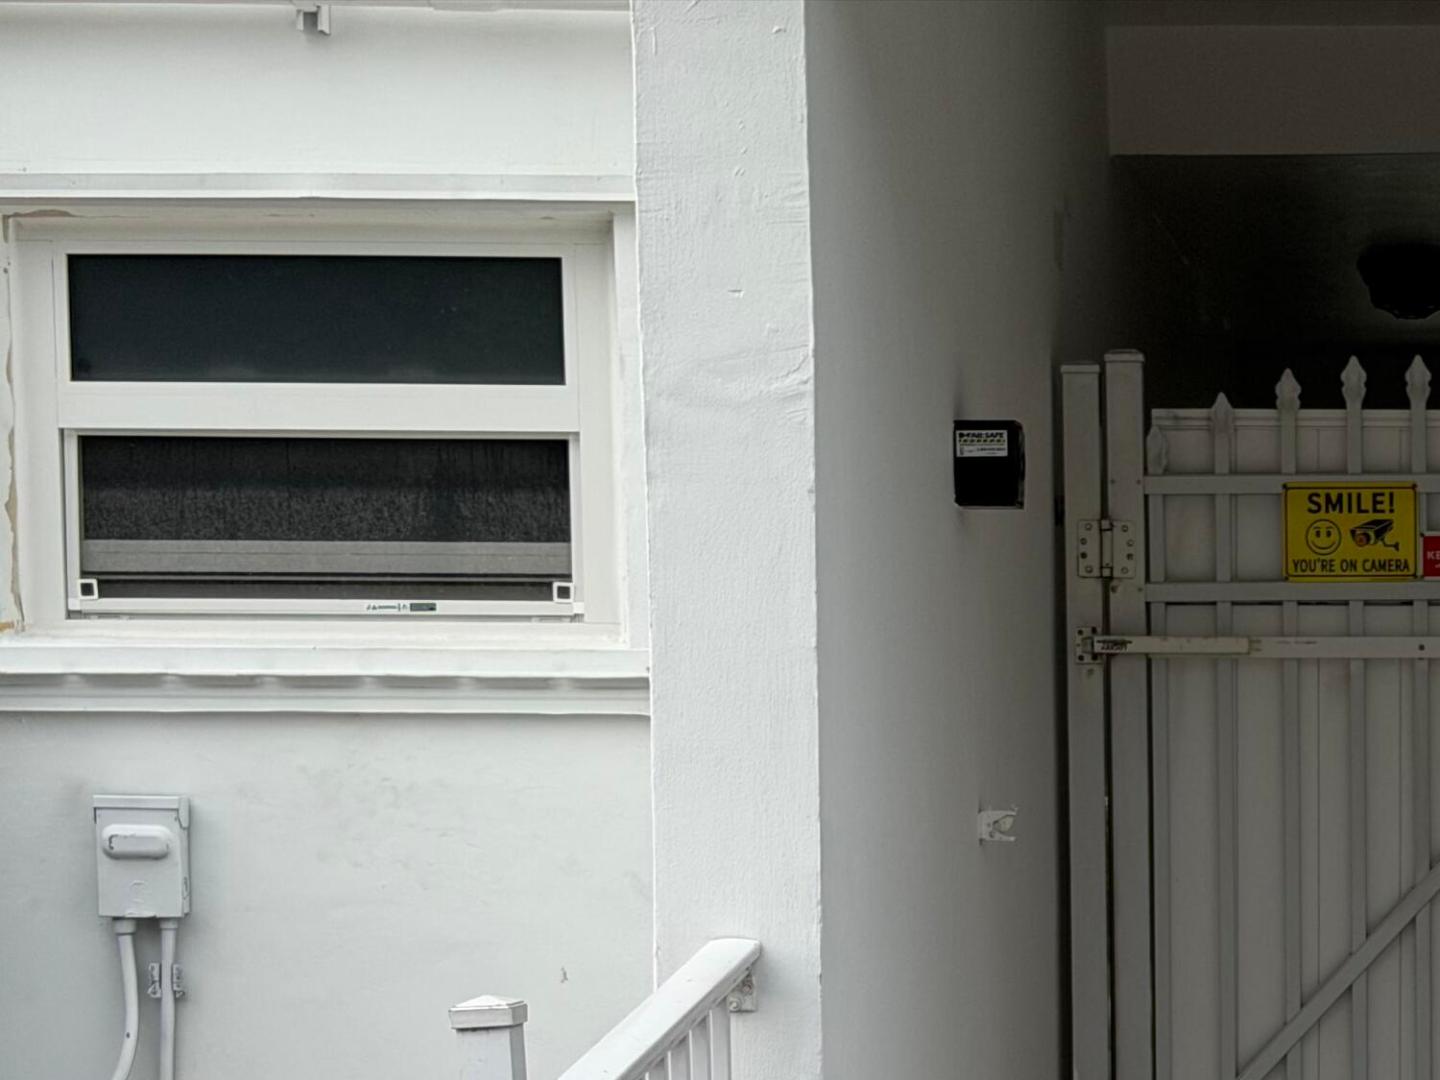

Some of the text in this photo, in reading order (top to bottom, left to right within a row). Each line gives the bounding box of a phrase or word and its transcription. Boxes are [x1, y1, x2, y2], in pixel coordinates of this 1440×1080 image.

[1307, 492, 1395, 514] SMILE!
[1293, 558, 1409, 573] YOU'RE ON CAMERA
